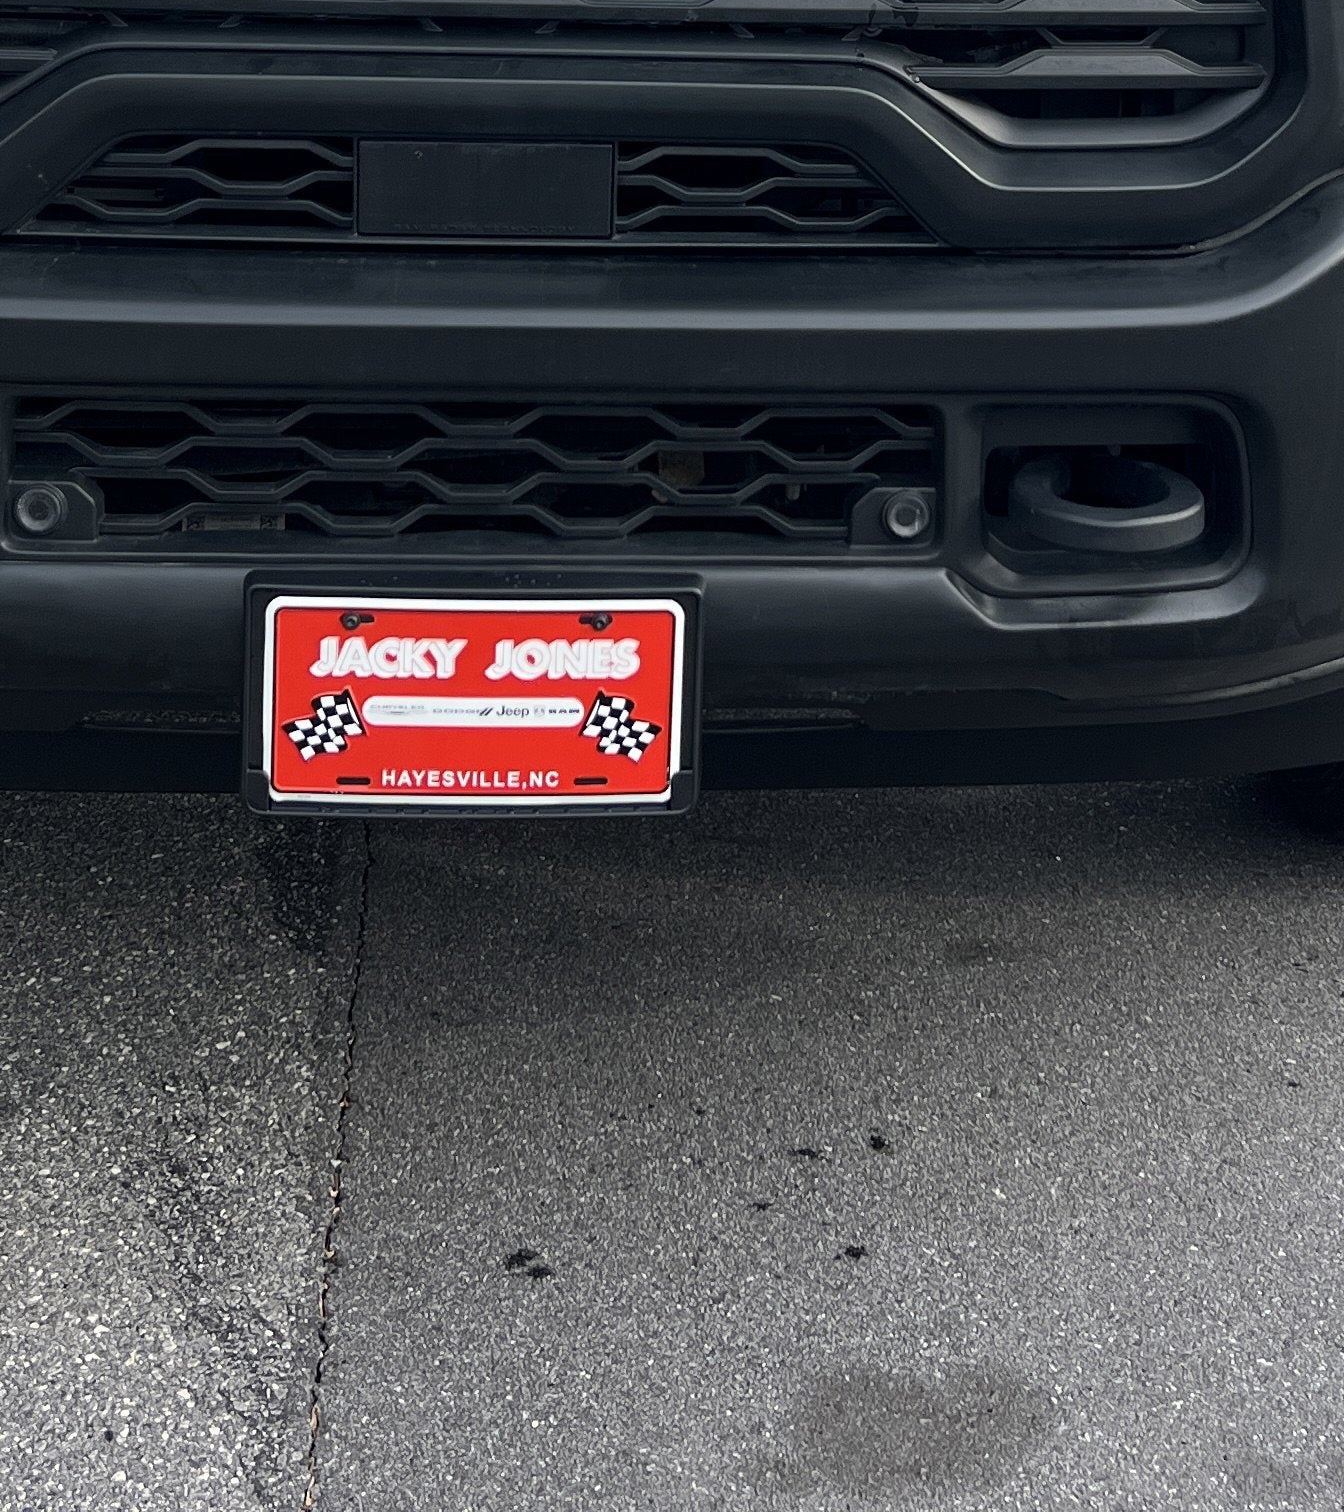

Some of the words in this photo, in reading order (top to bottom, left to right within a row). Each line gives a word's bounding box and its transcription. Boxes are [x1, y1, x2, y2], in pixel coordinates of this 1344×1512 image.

[309, 635, 468, 679] JACKY
[484, 637, 641, 681] JONES
[496, 705, 530, 719] Jeep
